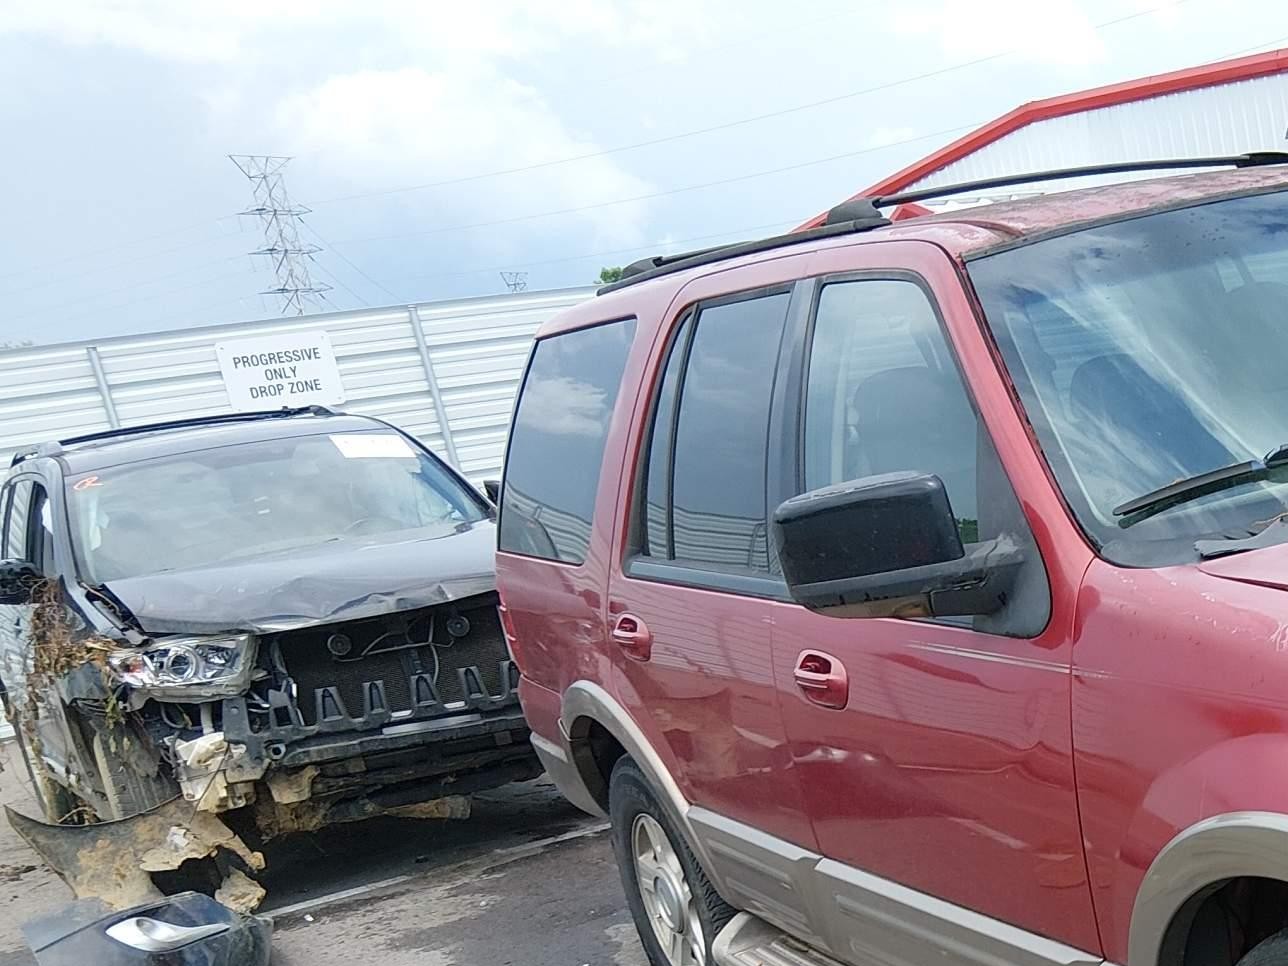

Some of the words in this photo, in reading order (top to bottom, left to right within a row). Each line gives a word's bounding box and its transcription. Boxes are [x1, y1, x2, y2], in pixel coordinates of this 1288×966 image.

[232, 347, 321, 369] PROGRESSIVE
[264, 366, 297, 381] ONLY
[249, 383, 284, 399] DROP
[288, 379, 322, 394] ZONE
